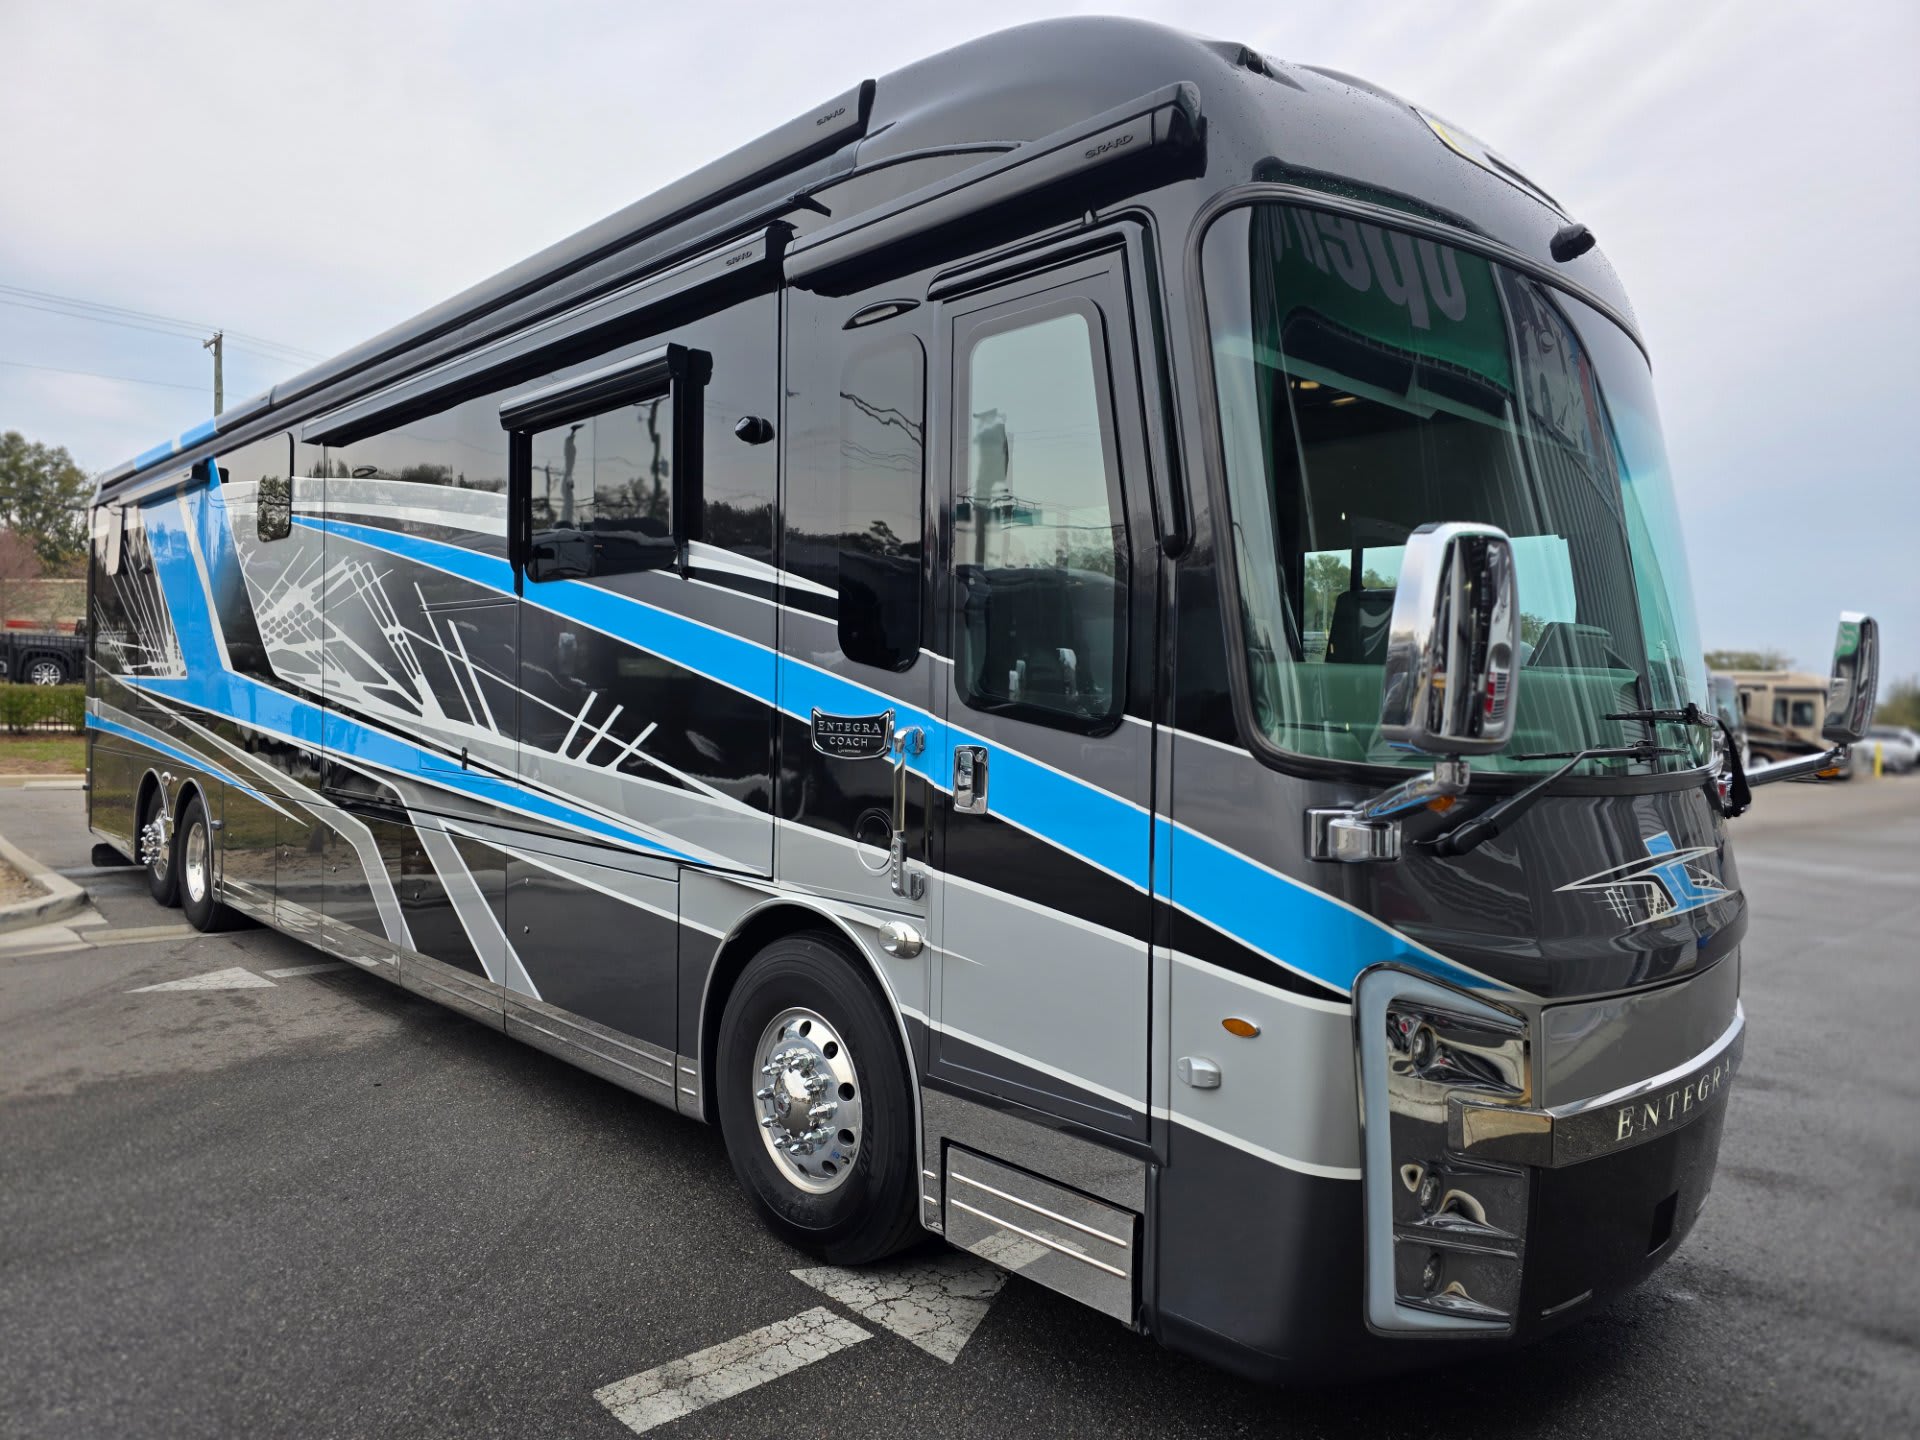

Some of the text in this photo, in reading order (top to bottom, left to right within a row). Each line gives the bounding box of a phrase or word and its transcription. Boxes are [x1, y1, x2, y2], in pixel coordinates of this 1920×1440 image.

[817, 720, 882, 734] ENTEGRA
[829, 736, 868, 747] COACH
[1615, 1057, 1732, 1142] ENTEGRA
